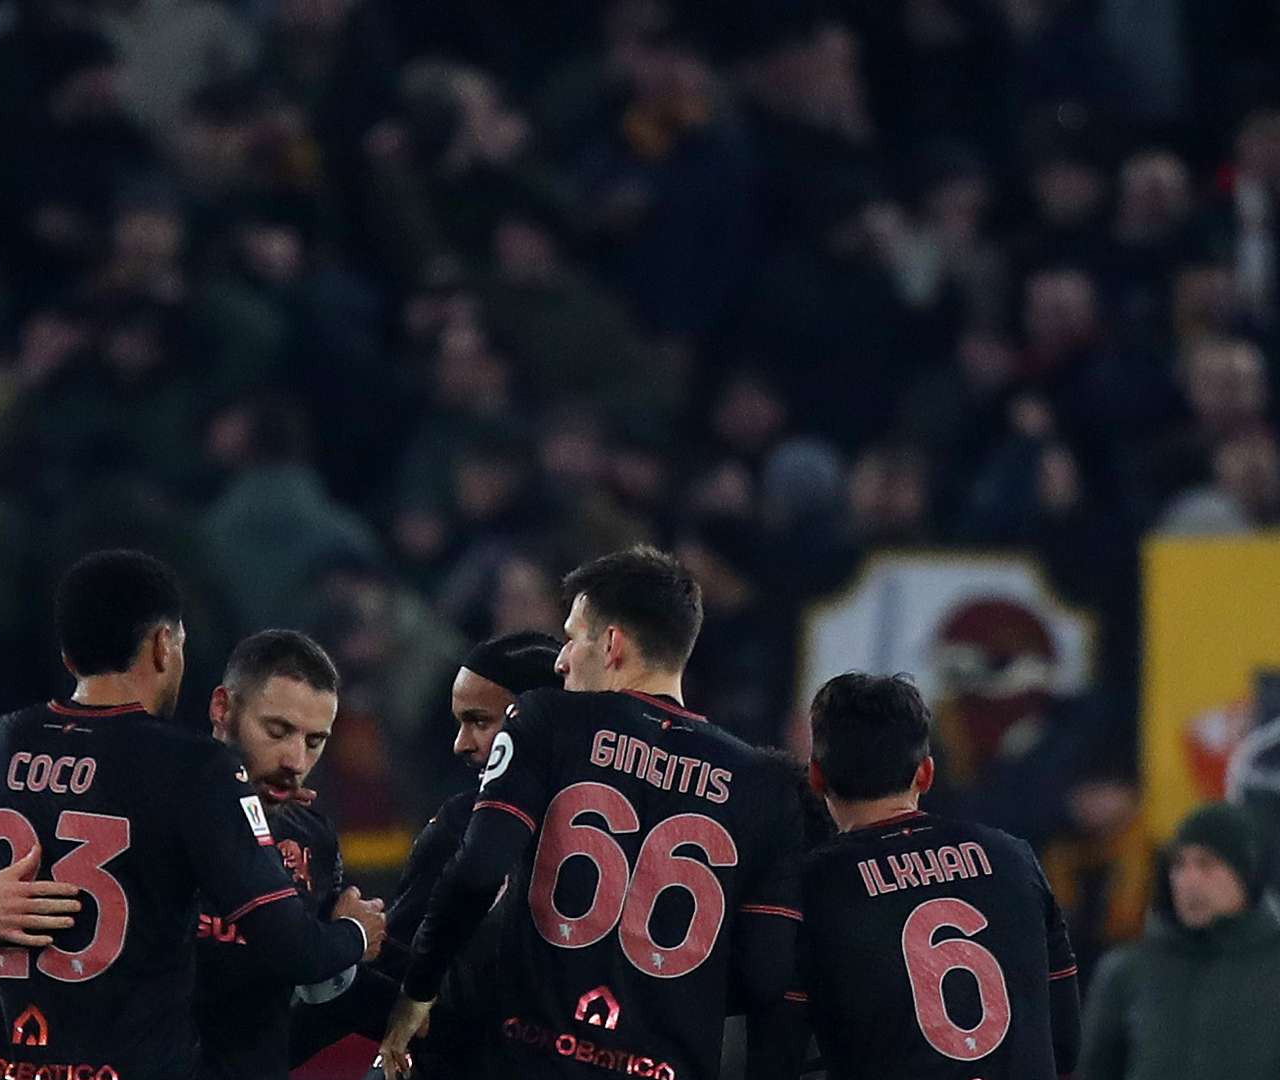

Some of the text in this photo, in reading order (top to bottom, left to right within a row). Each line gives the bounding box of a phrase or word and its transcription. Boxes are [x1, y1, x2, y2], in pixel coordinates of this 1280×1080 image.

[7, 751, 96, 795] COCO
[590, 729, 733, 804] GINEITIS
[528, 781, 738, 978] 66
[857, 840, 993, 897] ILKHAN
[902, 897, 1011, 1061] 6
